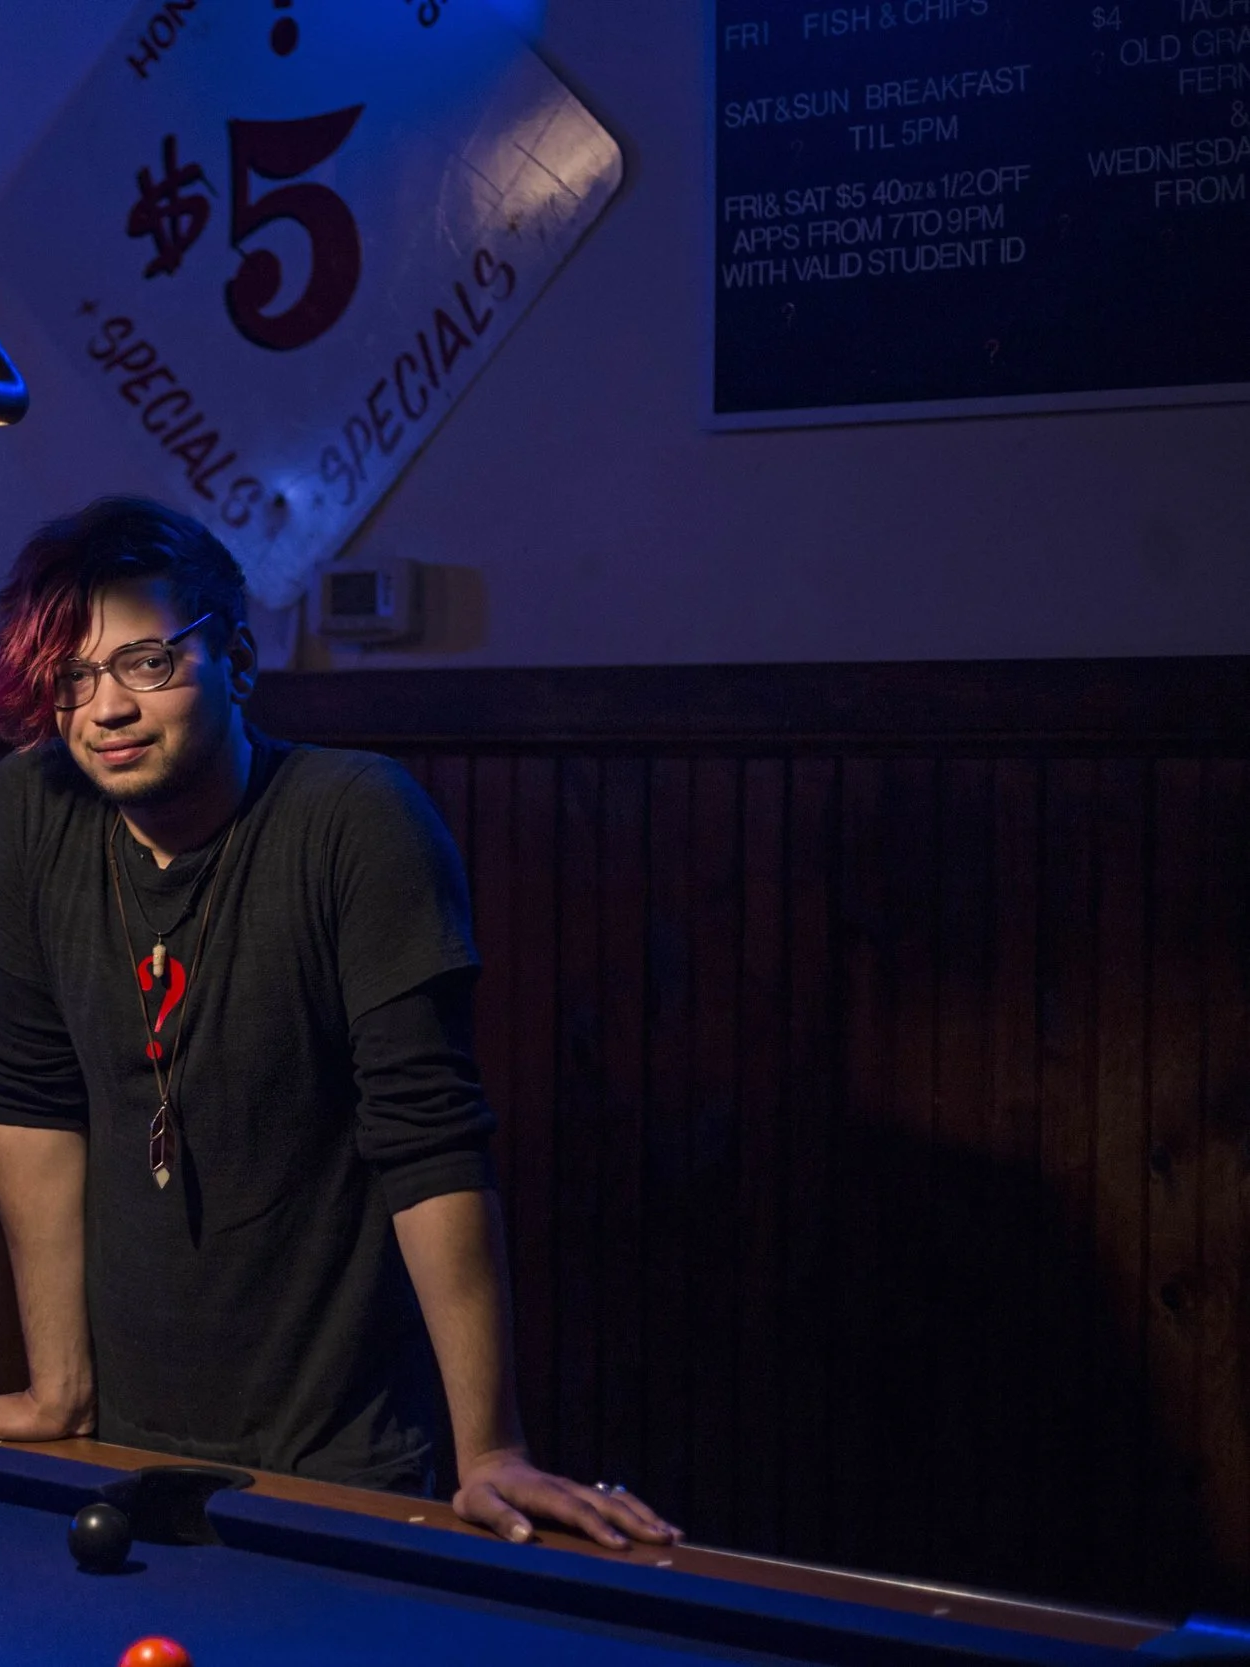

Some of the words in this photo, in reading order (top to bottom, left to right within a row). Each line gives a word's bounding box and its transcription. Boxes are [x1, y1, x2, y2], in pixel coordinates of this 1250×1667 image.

[724, 20, 769, 51] FRI
[803, 5, 871, 40] FISH
[879, 2, 898, 29] &
[1091, 5, 1122, 32] $4
[1120, 34, 1181, 67] OLD
[865, 64, 1032, 110] BREAKFAST
[848, 123, 896, 151] TIL
[901, 114, 960, 146] 5PM
[1230, 99, 1250, 129] &
[784, 185, 832, 216] SAT
[836, 182, 867, 209] $5
[926, 180, 937, 199] &
[1154, 173, 1246, 209] FROM
[126, 104, 367, 352] $5
[733, 225, 800, 255] APPS
[809, 215, 883, 248] FROM
[905, 210, 943, 237] TO
[722, 257, 788, 290] WITH
[793, 251, 862, 282] VALID
[868, 238, 994, 276] STUDENT
[999, 236, 1026, 265] ID
[318, 247, 517, 506] SPECIALS
[87, 315, 266, 529] SPECIALS
